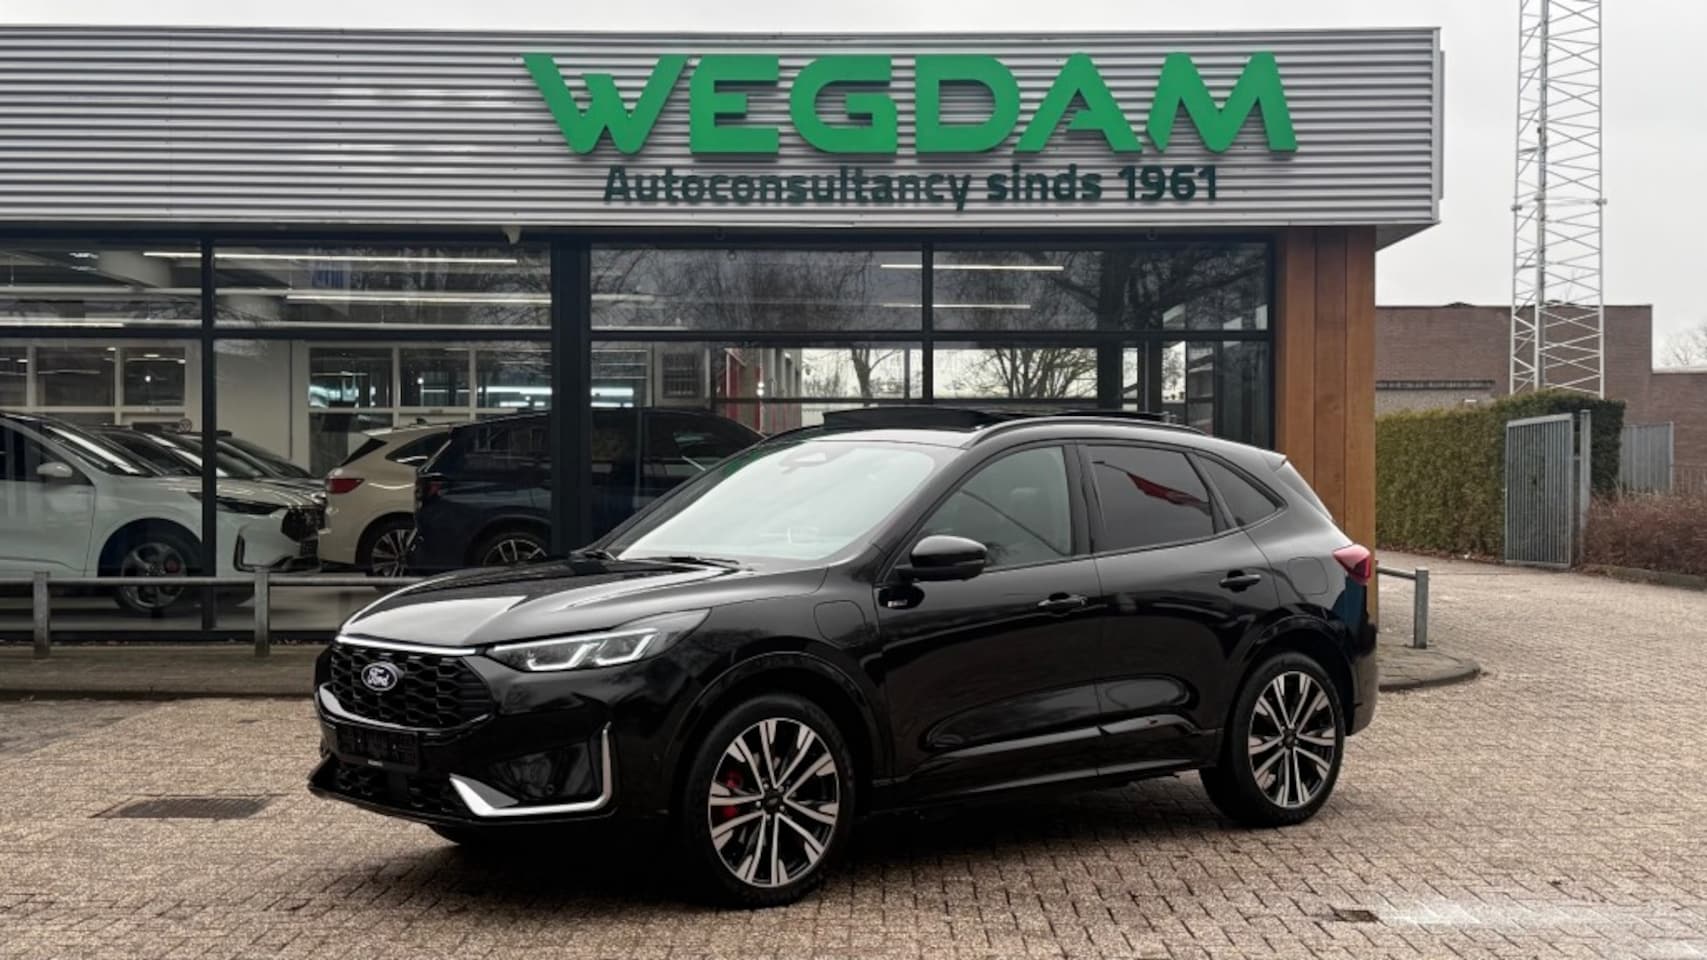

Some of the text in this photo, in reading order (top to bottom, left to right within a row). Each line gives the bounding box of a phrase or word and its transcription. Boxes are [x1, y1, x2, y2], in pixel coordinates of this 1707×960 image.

[524, 52, 1298, 155] WEGDAM
[604, 164, 1217, 212] Autoconsultancy sinds 1961
